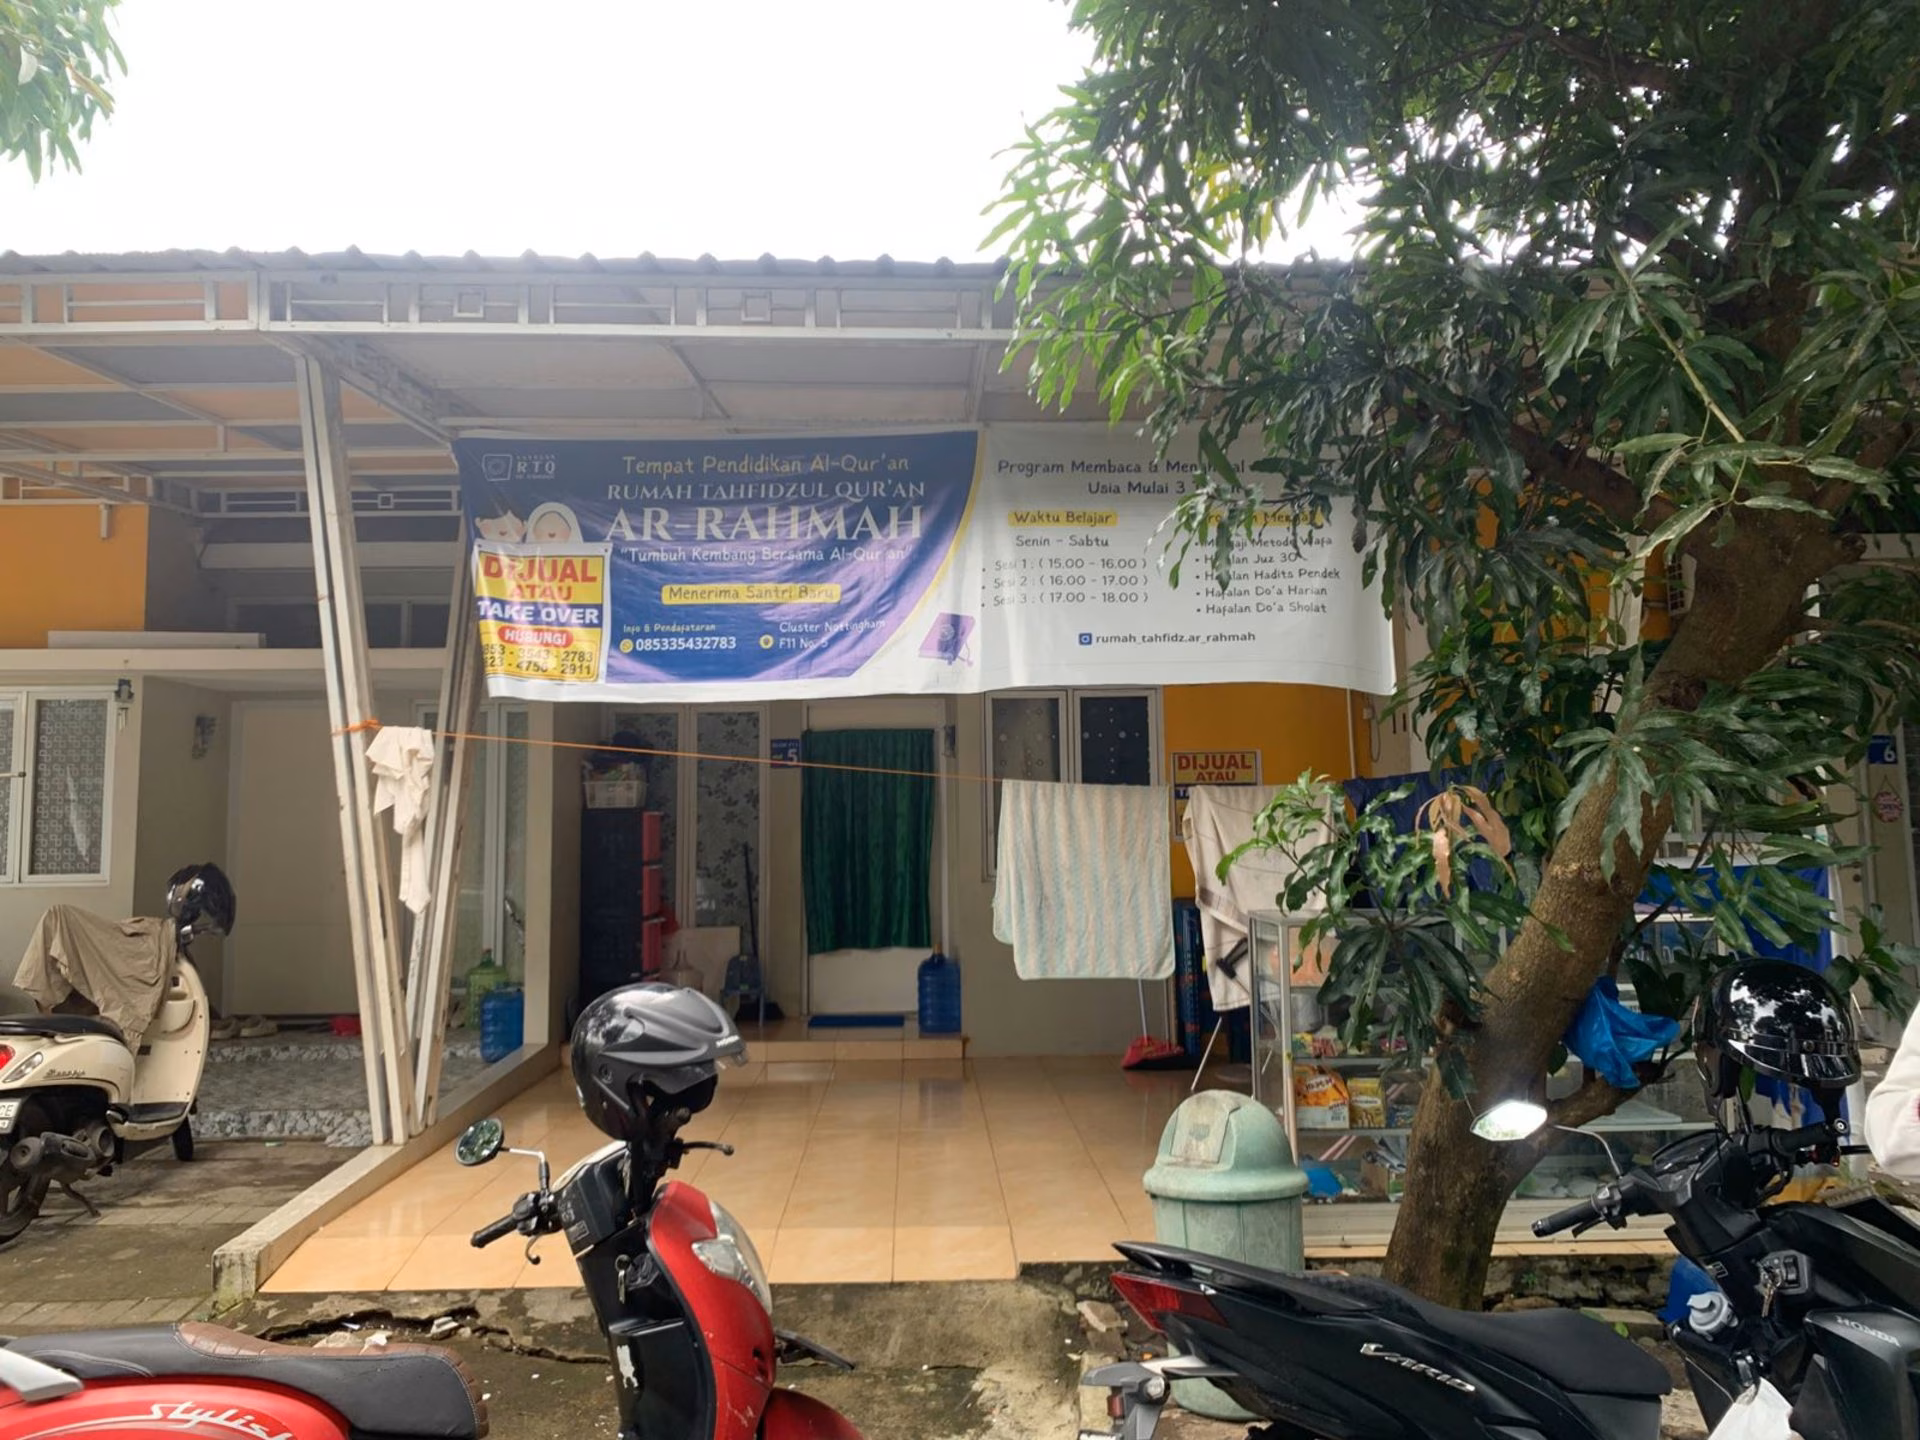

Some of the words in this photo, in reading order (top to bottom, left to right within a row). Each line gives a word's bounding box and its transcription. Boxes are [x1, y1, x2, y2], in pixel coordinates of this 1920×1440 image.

[623, 456, 694, 480] Tempat
[703, 453, 801, 474] Pendidikan
[810, 452, 909, 473] Al-Qur'an
[998, 460, 1064, 478] Program
[1071, 459, 1141, 473] Membaca
[607, 483, 692, 500] RUMAH
[699, 481, 829, 499] TAHFIDZUL
[835, 479, 925, 502] QUR'AN
[1088, 481, 1120, 494] Usia
[1127, 480, 1168, 494] Mulai
[1176, 481, 1185, 494] 3
[604, 504, 923, 541] AR-RAHMAH
[1013, 510, 1060, 523] Waktu
[1066, 510, 1112, 527] Belajar
[1015, 535, 1050, 547] Senin
[1068, 534, 1109, 547] Sabtu
[692, 547, 756, 565] Kembang
[762, 547, 824, 561] Bersama
[1253, 554, 1275, 564] Juz
[1280, 552, 1298, 563] 30
[1298, 567, 1341, 579] Pendek
[512, 584, 573, 600] ATAU
[669, 585, 740, 600] Menerima
[745, 584, 793, 599] Santri
[798, 584, 834, 599] Baru
[1205, 585, 1250, 600] Hafalan
[1255, 585, 1283, 596] Do'a
[1288, 584, 1328, 596] Harian
[477, 600, 535, 621] TAKE
[541, 607, 600, 624] OVER
[1206, 603, 1251, 616] Hafalan
[1256, 602, 1284, 613] Do'a
[1289, 601, 1328, 613] Sholat
[623, 623, 641, 635] Info
[779, 621, 820, 633] Cluster
[824, 618, 887, 633] Nottingham
[635, 636, 737, 651] 085335432783
[779, 637, 796, 649] F11
[1095, 631, 1256, 645] rumah_tahfidz.ar_rahmah
[562, 650, 593, 662] 2783
[787, 748, 798, 764] 5
[1883, 743, 1896, 762] 6
[1177, 754, 1253, 770] DIJUAL
[1195, 771, 1236, 782] ATAU
